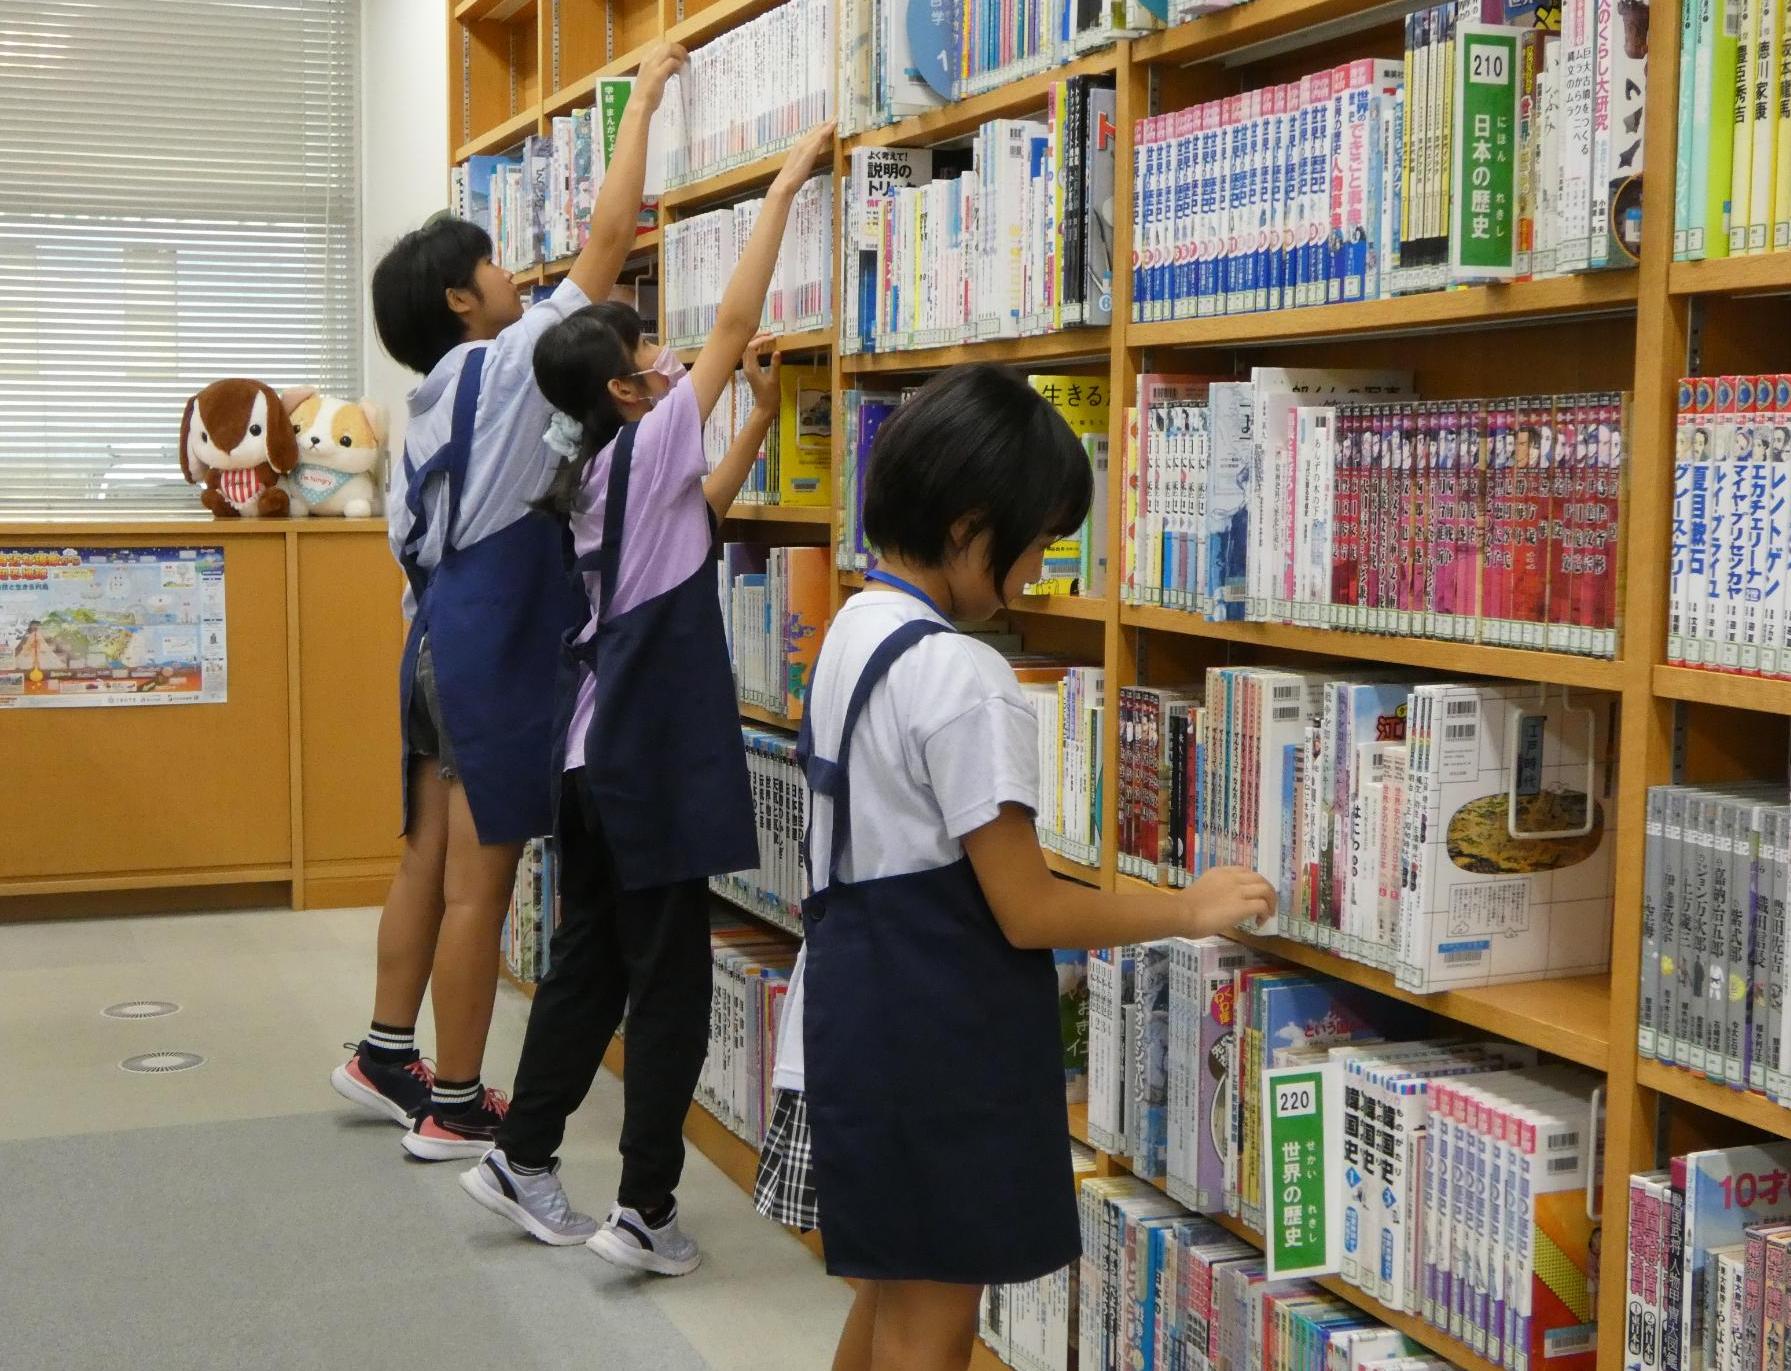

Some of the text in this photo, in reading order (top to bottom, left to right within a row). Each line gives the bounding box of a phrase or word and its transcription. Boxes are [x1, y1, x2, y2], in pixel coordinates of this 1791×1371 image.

[1356, 89, 1369, 122] 世界の
[1473, 55, 1503, 78] 210
[1756, 41, 1770, 121] 徳川家康
[867, 163, 912, 179] 説明の
[867, 180, 917, 197] トリ
[1471, 114, 1491, 240] 日本の歴史
[1495, 115, 1506, 238] にほん れきし
[1042, 384, 1110, 407] 生きる
[1672, 463, 1691, 594] グレース・ケリー
[1690, 466, 1709, 575] 夏目漱石
[1727, 465, 1749, 600] マイヤ・プリセツカヤ
[1765, 465, 1786, 598] レントゲン
[1280, 1090, 1310, 1111] 220
[1282, 1141, 1302, 1248] 世界の歴史
[1305, 1141, 1318, 1242] せかい れきし
[1719, 1169, 1791, 1209] 10才
